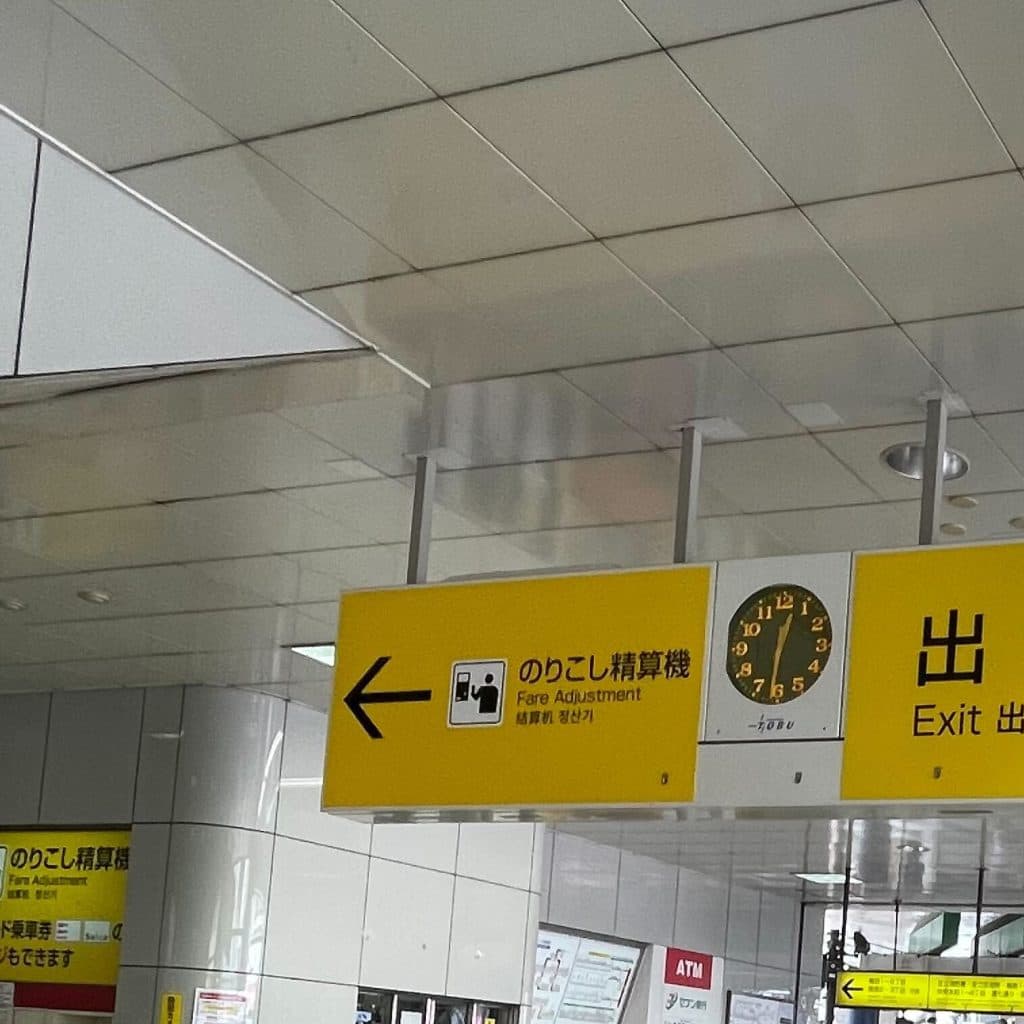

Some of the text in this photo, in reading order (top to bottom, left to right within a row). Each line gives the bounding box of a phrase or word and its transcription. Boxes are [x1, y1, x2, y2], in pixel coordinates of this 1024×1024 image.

[776, 594, 793, 609] 12
[801, 602, 808, 615] 1
[758, 606, 772, 620] 11
[743, 623, 761, 637] 10
[811, 617, 824, 631] 2
[735, 641, 748, 656] 9
[816, 638, 827, 652] 3
[518, 648, 691, 684] のりこし精算機
[740, 662, 752, 677] 8
[808, 659, 820, 673] 4
[753, 678, 764, 693] 7
[791, 677, 804, 692] 5
[516, 687, 641, 706] Fare Adjustment
[756, 714, 795, 733] TOBU
[913, 703, 982, 737] Exit
[676, 959, 704, 979] ATM
